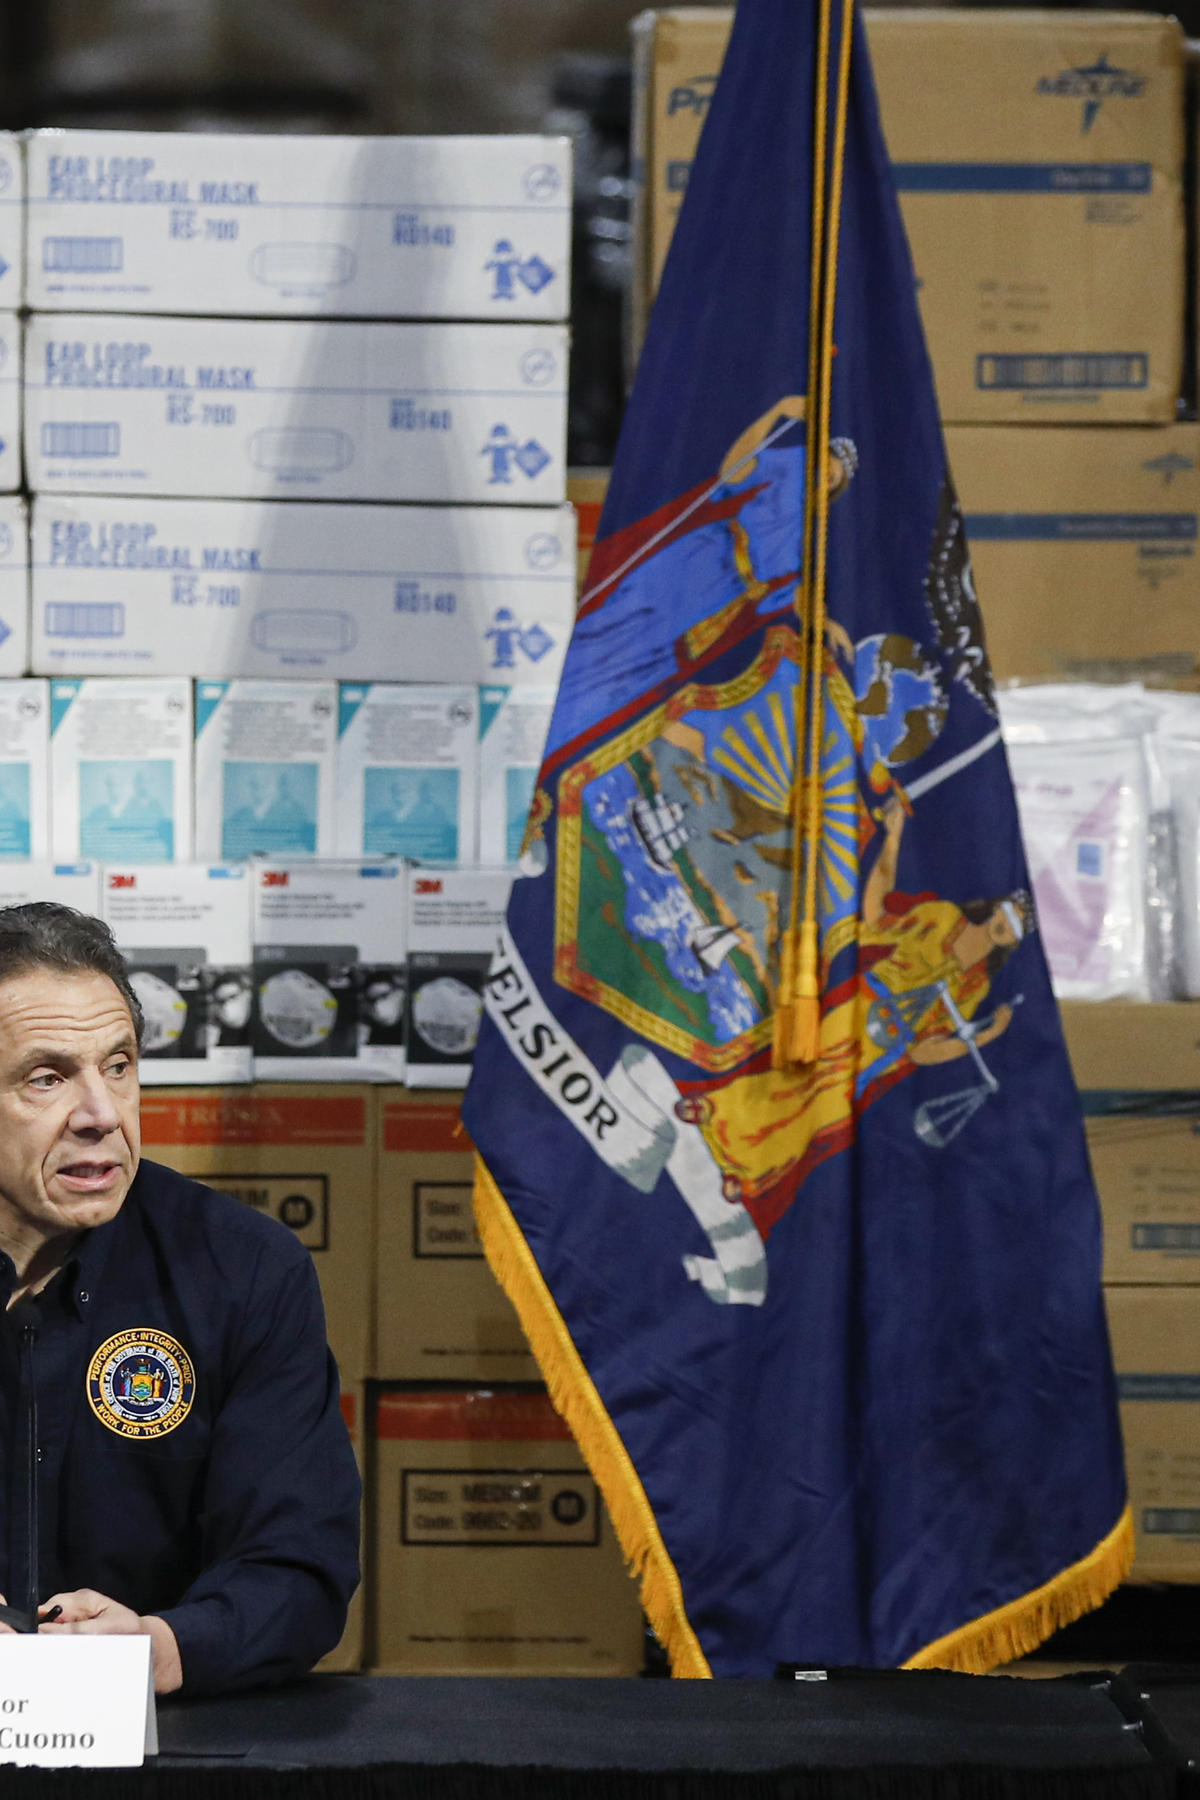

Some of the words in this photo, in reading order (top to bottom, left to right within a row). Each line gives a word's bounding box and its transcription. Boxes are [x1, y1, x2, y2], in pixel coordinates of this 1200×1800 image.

[50, 156, 89, 178] EAR
[97, 157, 154, 178] LOOP
[50, 177, 190, 203] PROCEDURAL
[201, 181, 258, 204] MASK
[45, 342, 85, 364] EAR
[96, 343, 151, 364] LOOP
[45, 365, 187, 389] PROCEDURAL
[199, 368, 256, 390] MASK
[52, 520, 91, 543] EAR
[100, 522, 157, 544] LOOP
[51, 542, 191, 567] PROCEDURAL
[203, 549, 261, 571] MASK
[109, 875, 136, 889] 3M
[262, 872, 289, 886] 3M
[414, 879, 443, 894] 3M
[121, 1424, 140, 1435] FOR
[144, 1426, 161, 1435] THE
